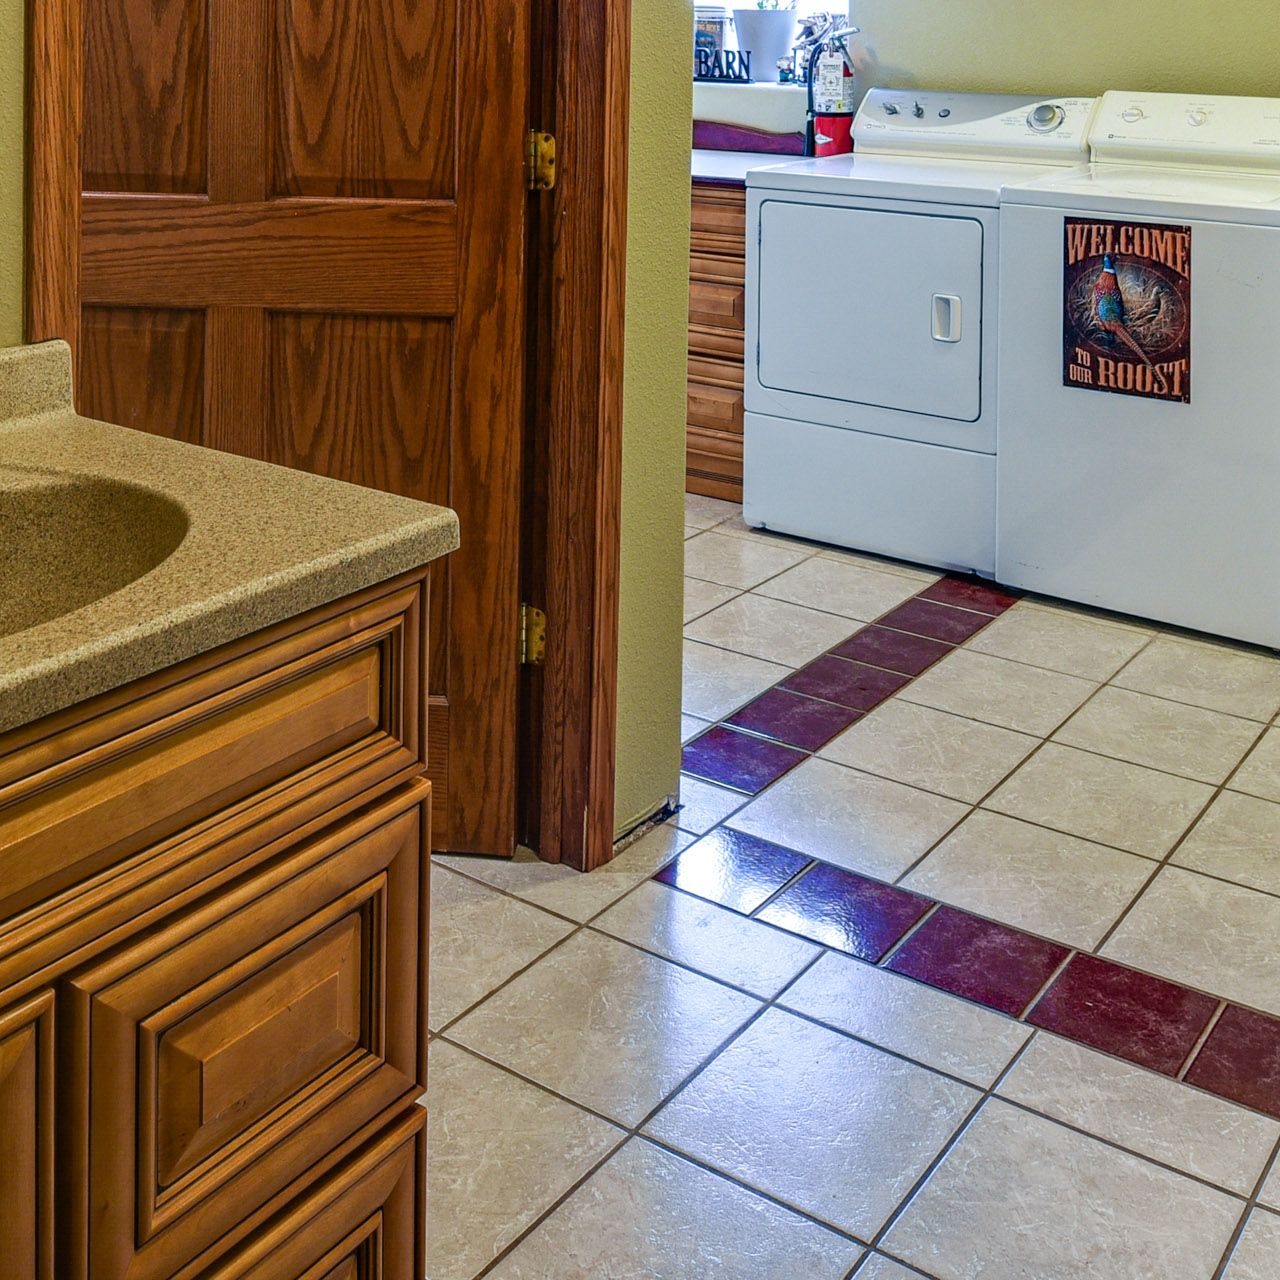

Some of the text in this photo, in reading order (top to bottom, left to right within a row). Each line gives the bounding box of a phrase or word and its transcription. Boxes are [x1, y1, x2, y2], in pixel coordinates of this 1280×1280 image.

[696, 48, 751, 79] BARN
[1066, 224, 1190, 280] WELCOME
[1075, 346, 1091, 367] TO
[1069, 364, 1093, 384] OUR
[1097, 356, 1188, 396] ROOST
